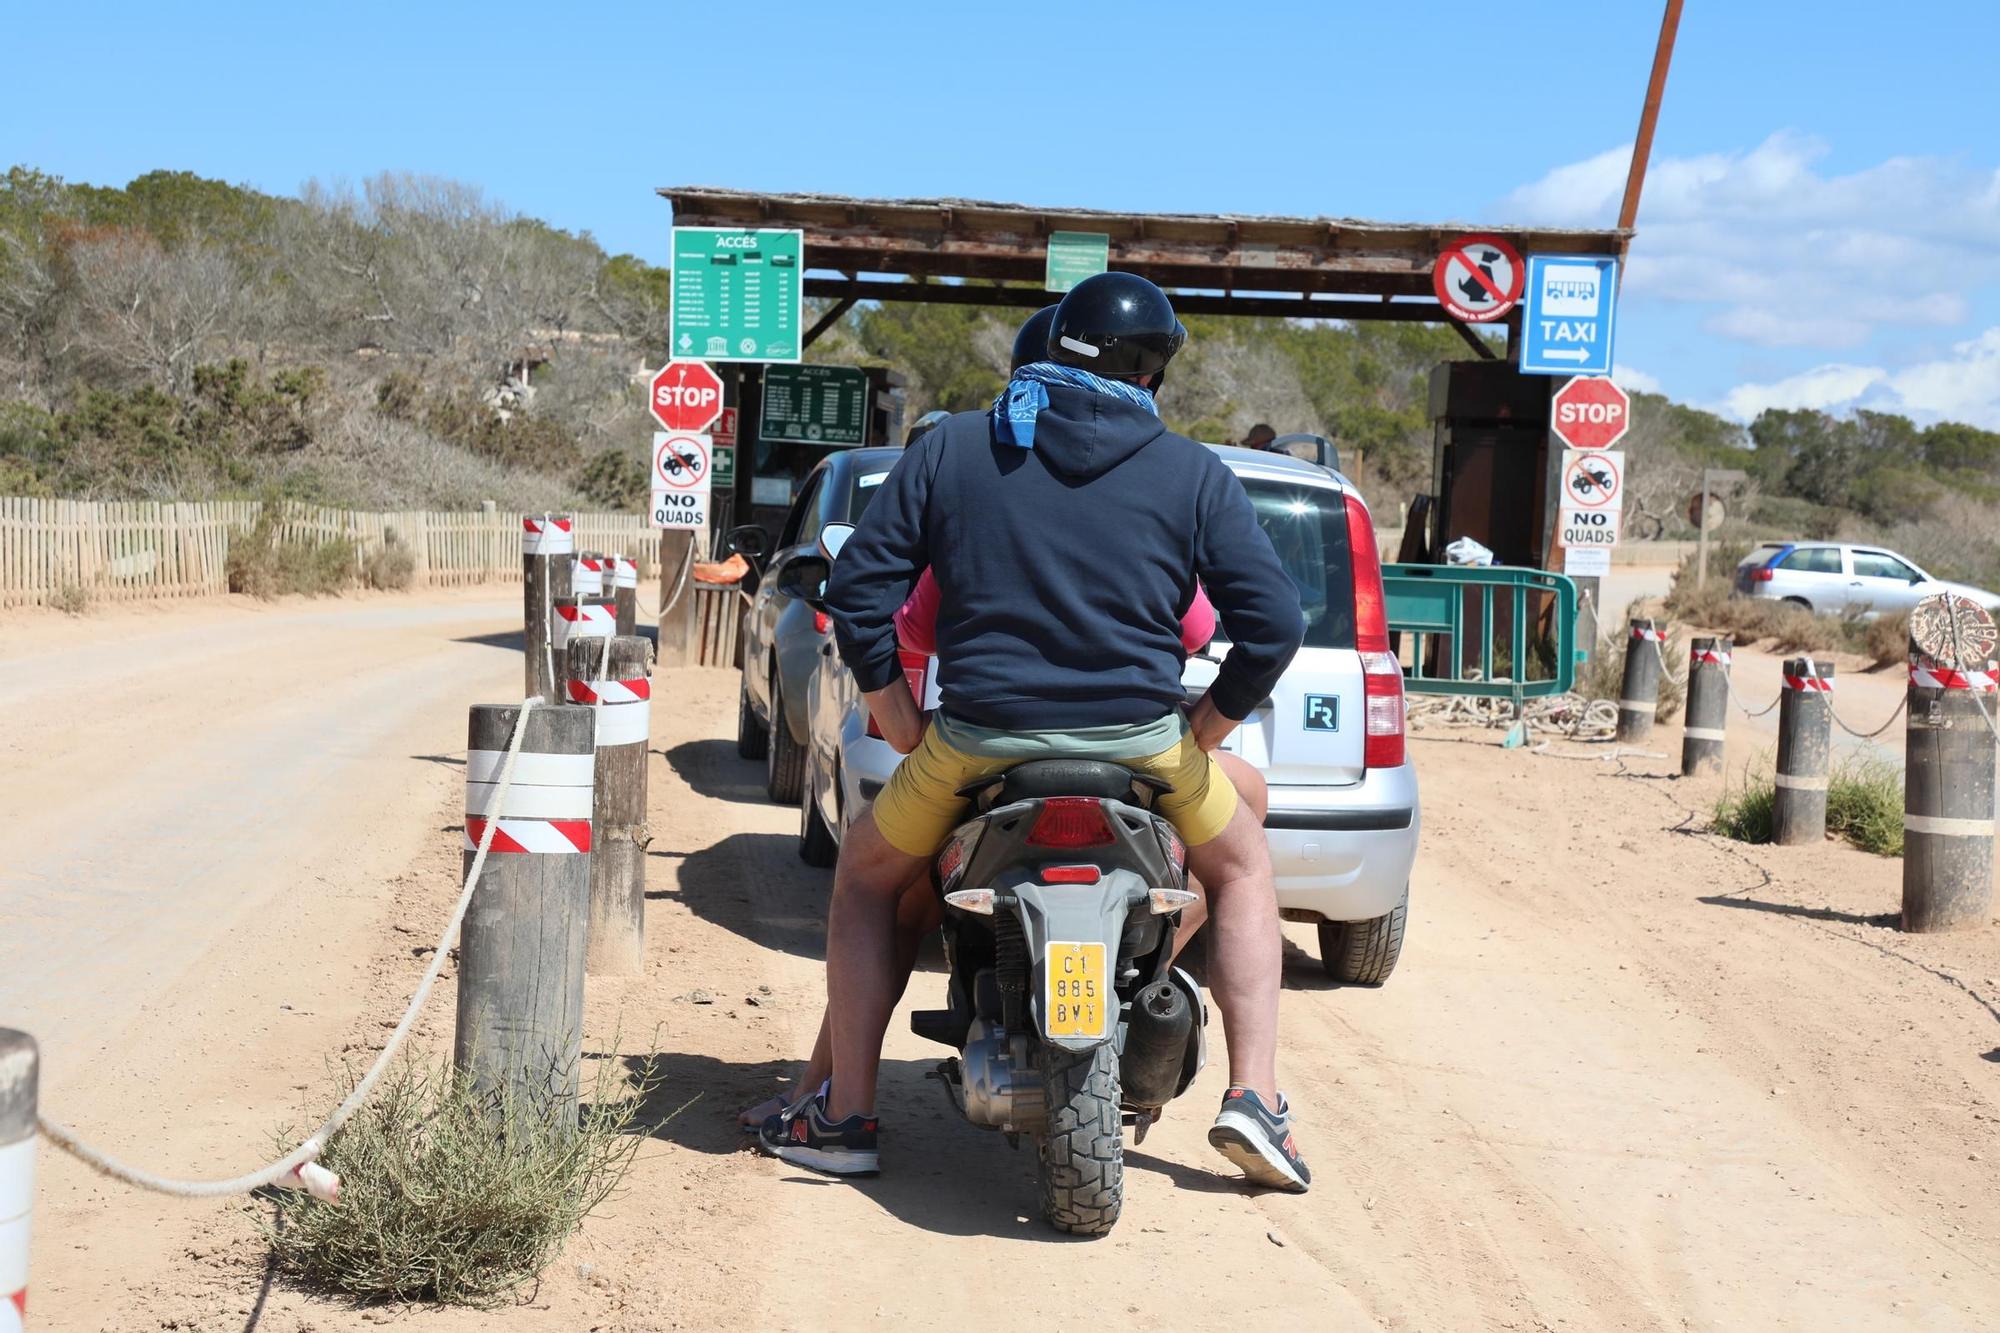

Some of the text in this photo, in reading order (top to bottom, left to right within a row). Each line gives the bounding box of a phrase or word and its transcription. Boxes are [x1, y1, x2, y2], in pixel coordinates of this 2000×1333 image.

[1540, 321, 1597, 343] TAXI
[656, 386, 717, 407] STOP
[1560, 402, 1622, 423] STOP
[665, 494, 696, 508] NO
[655, 509, 704, 524] QUADS
[1574, 513, 1607, 526] NO
[1564, 528, 1615, 544] QUADS
[1064, 956, 1087, 974] C1
[1057, 980, 1095, 998] 885
[790, 1119, 808, 1143] N
[1282, 1134, 1298, 1160] N
